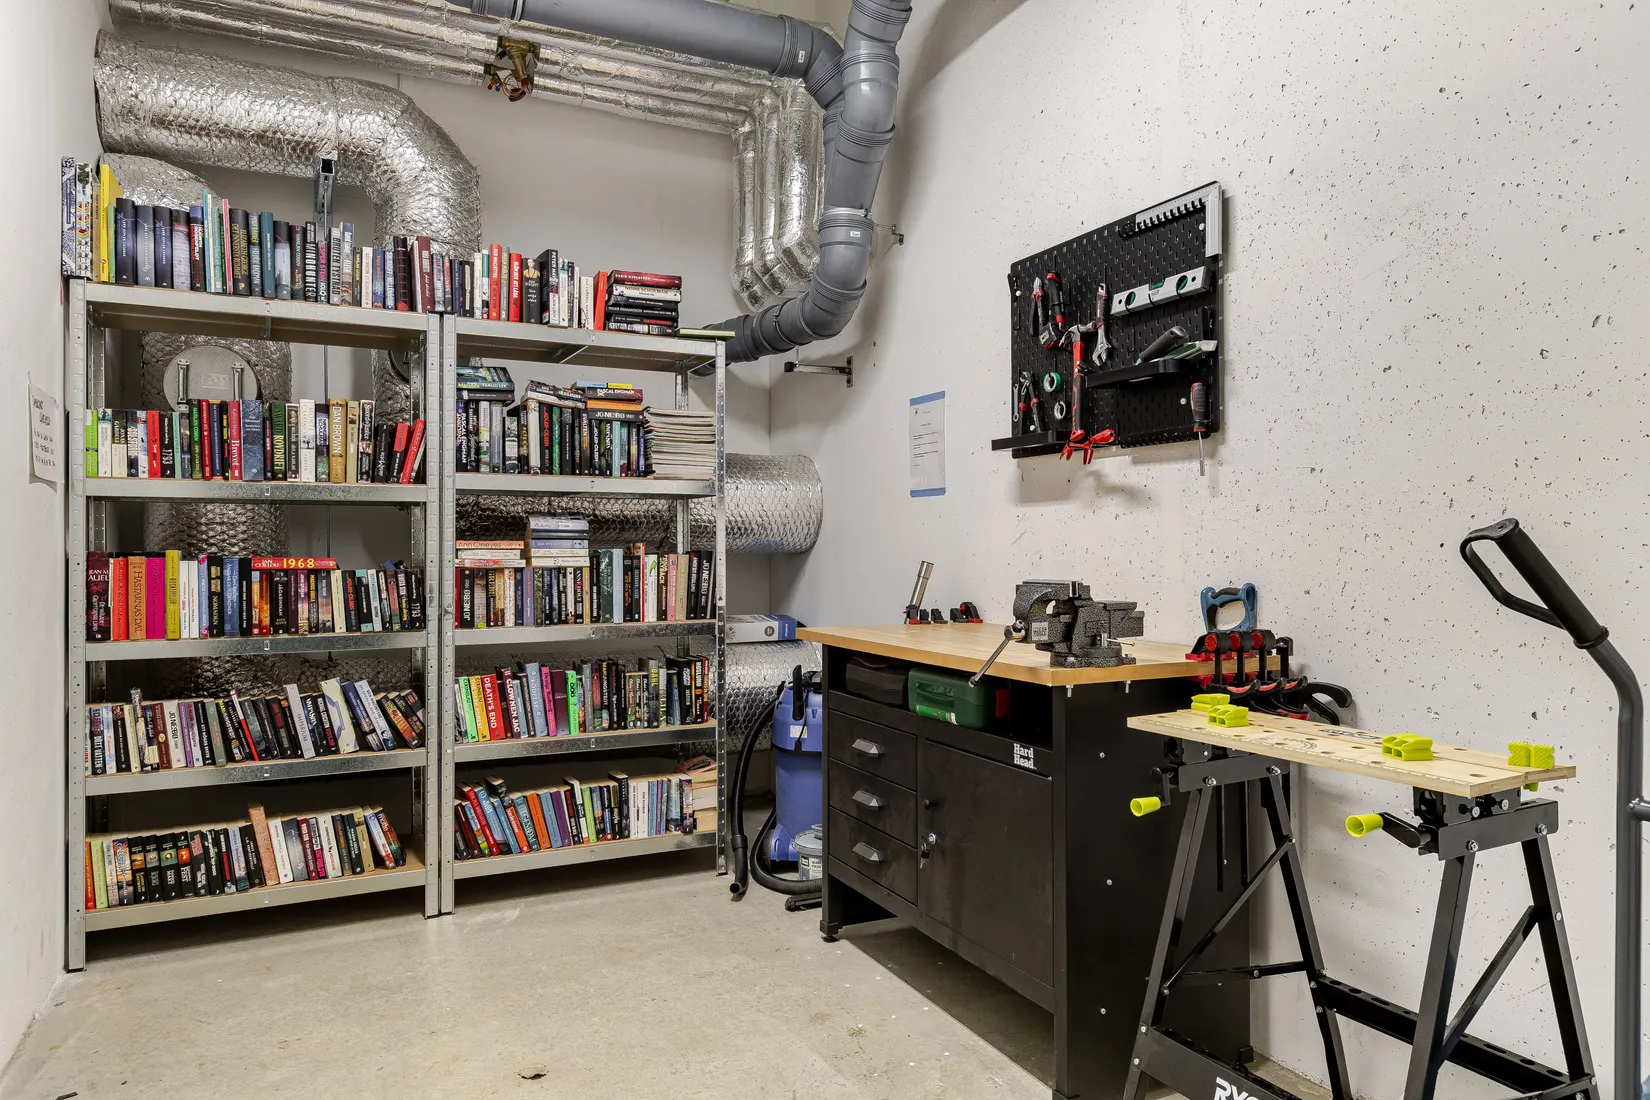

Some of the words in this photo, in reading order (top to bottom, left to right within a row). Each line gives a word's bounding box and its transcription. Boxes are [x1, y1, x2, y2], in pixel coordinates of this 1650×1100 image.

[332, 238, 341, 261] BRUTEN
[305, 244, 316, 297] MINDHUNTER
[332, 265, 340, 295] TYSTNAD
[332, 406, 342, 422] DAN
[596, 410, 604, 418] JO
[332, 424, 342, 454] BROWN
[162, 449, 172, 464] 1793
[231, 440, 240, 466] Brevet
[274, 435, 284, 470] ROVDRIFT
[283, 558, 315, 568] 1968
[703, 560, 709, 569] JO
[412, 603, 420, 617] 1793
[134, 618, 142, 634] DAL
[484, 677, 494, 710] DEATH'S
[489, 712, 497, 728] END
[506, 678, 517, 717] CLOWNEN
[512, 718, 520, 732] JAC
[168, 711, 176, 719] JO
[296, 714, 308, 742] IMPERIUM
[1014, 743, 1034, 758] Hard
[1014, 753, 1034, 768] Head
[1214, 1077, 1259, 1100] RY
